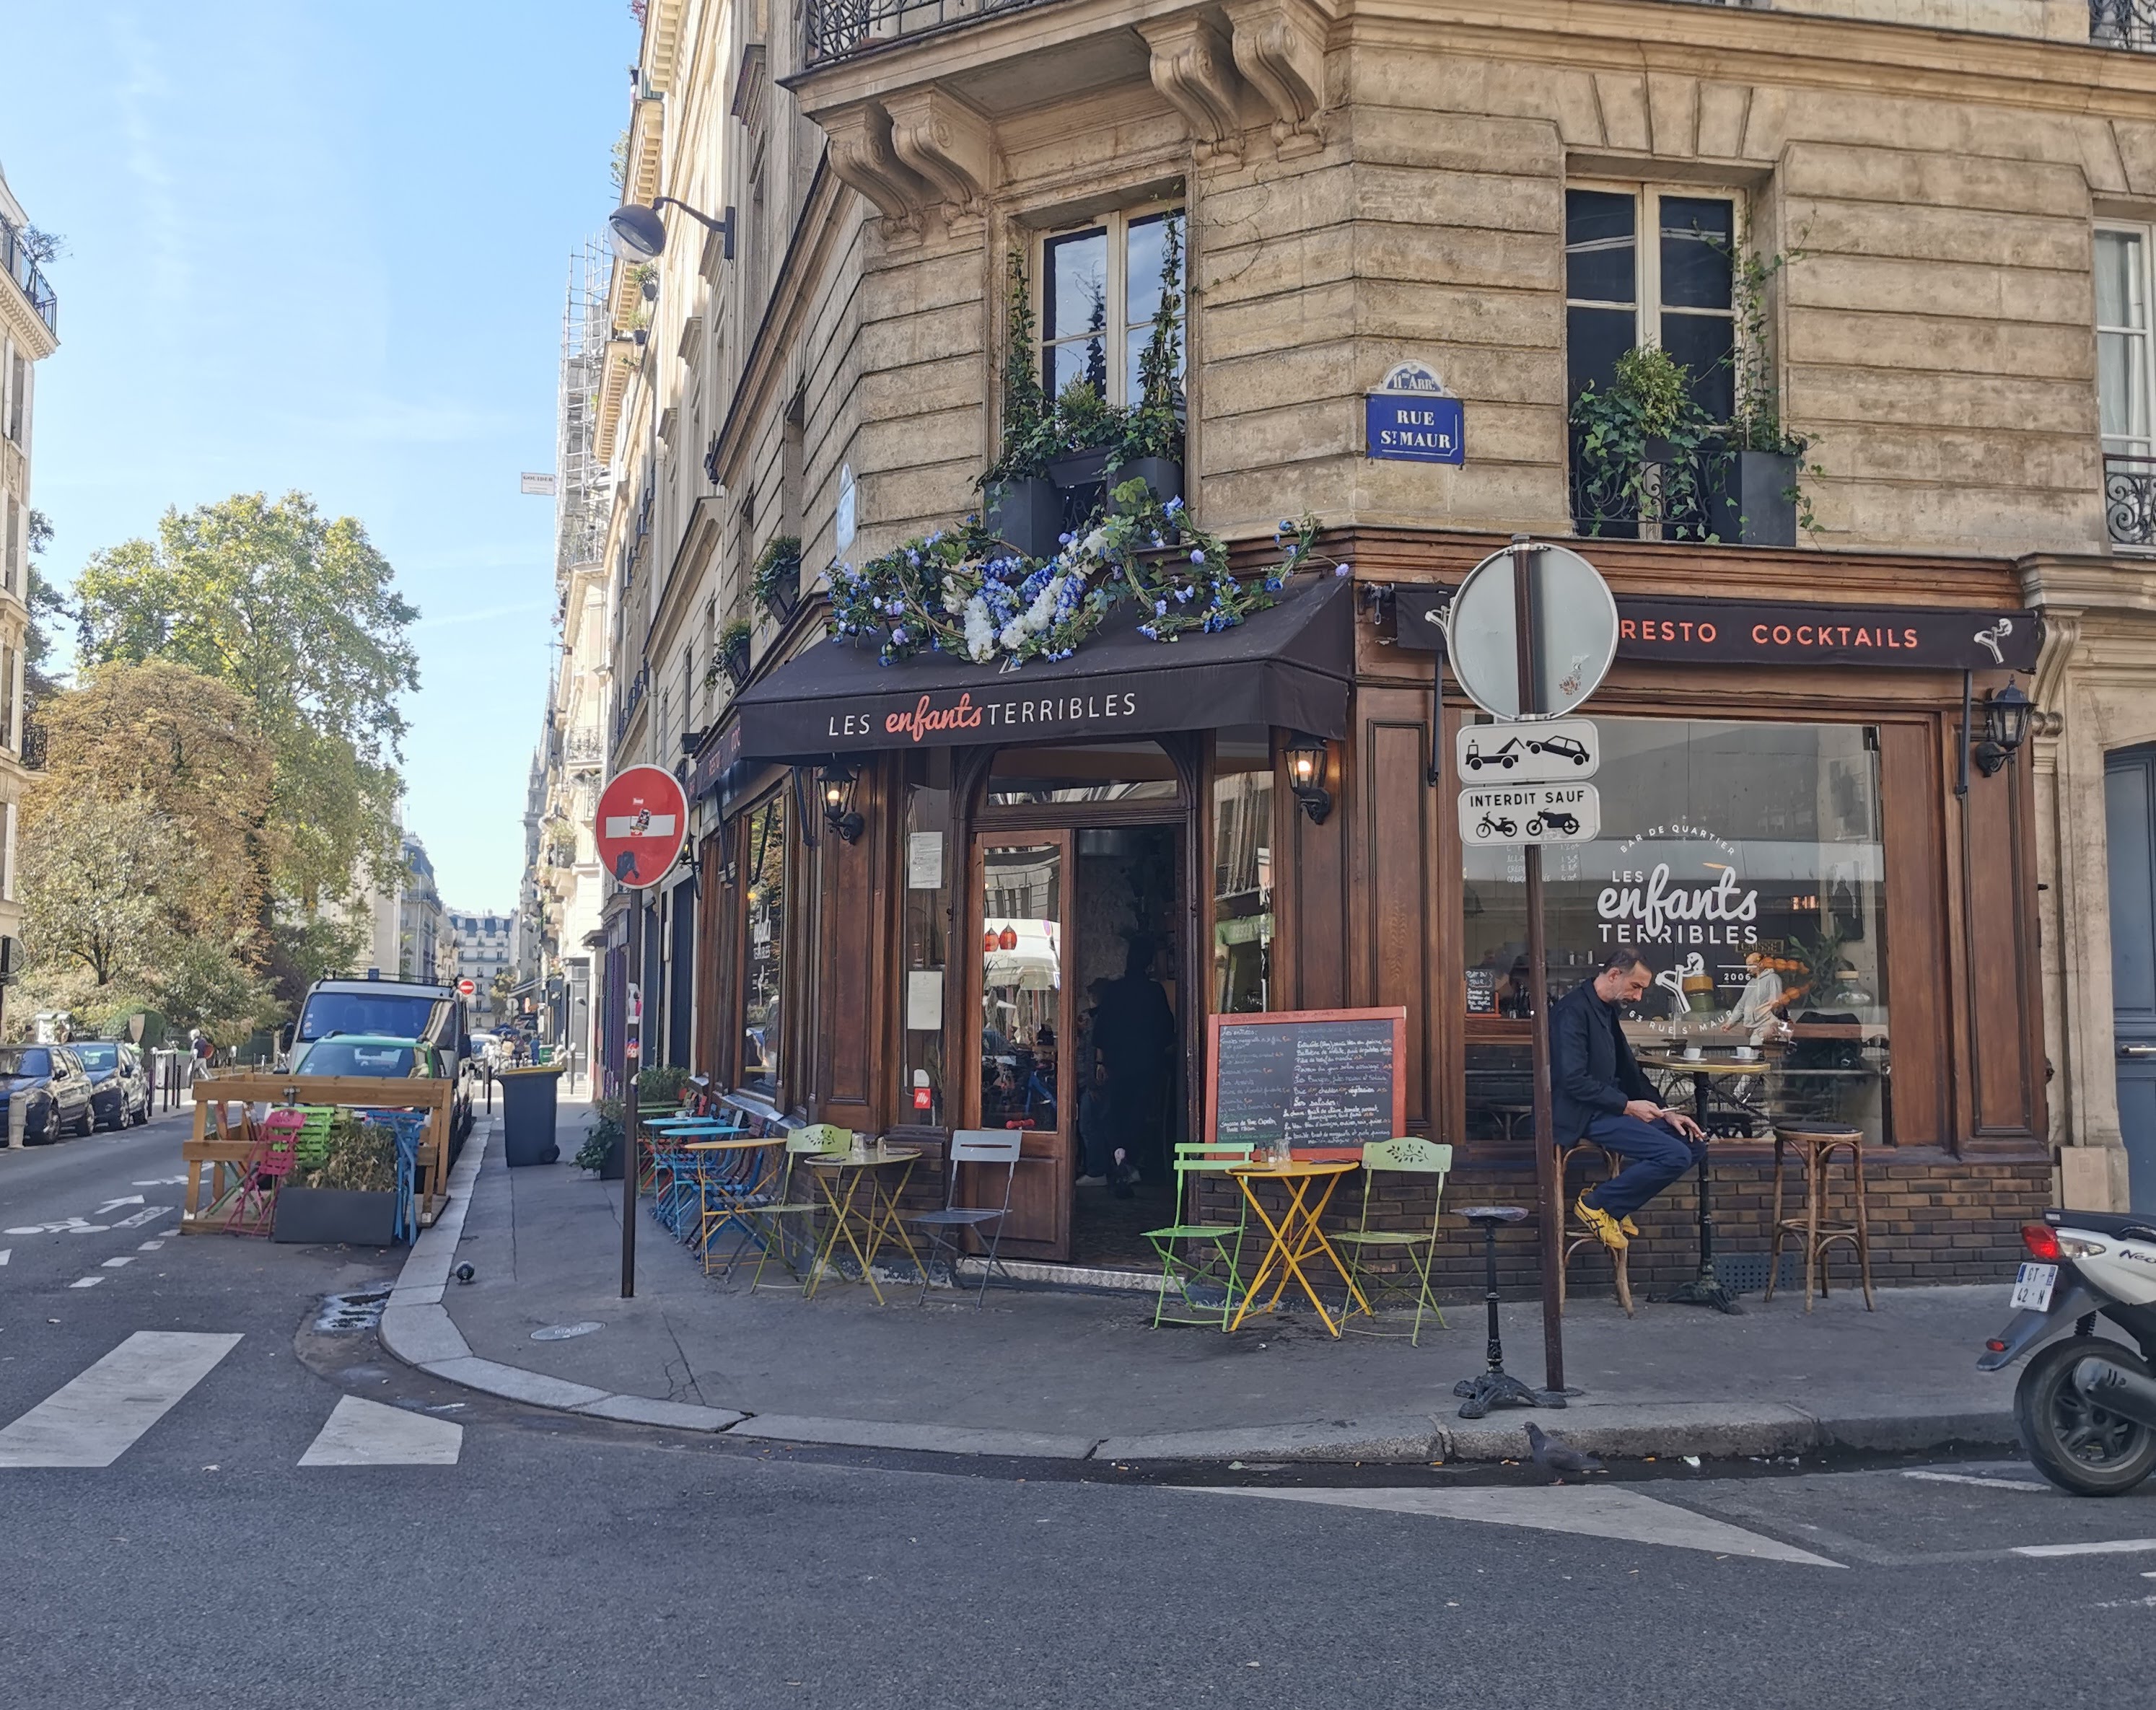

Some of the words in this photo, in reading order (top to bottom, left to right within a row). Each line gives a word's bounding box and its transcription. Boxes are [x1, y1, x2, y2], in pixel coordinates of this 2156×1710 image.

[1397, 409, 1434, 426] RUE
[1400, 431, 1451, 449] MAUR
[1620, 620, 1717, 642] RESTO
[1751, 624, 1919, 648] COCKTAILS
[828, 714, 871, 737] LES
[885, 693, 982, 742] enfants
[986, 692, 1136, 726] TERRIBLES
[1470, 792, 1536, 807] INTERDIT
[1545, 789, 1585, 804] SAUF
[1620, 833, 1643, 854] BAR
[1648, 825, 1665, 837] DE
[1671, 824, 1735, 855] QUARTIER
[1612, 869, 1644, 883] LES
[1597, 863, 1758, 937] enfants
[1598, 924, 1758, 944] TERRIBLES
[1723, 973, 1752, 981] 2006
[1629, 1009, 1644, 1022] 63
[1649, 1021, 1674, 1034] RUE
[1698, 1009, 1733, 1032] MAUR
